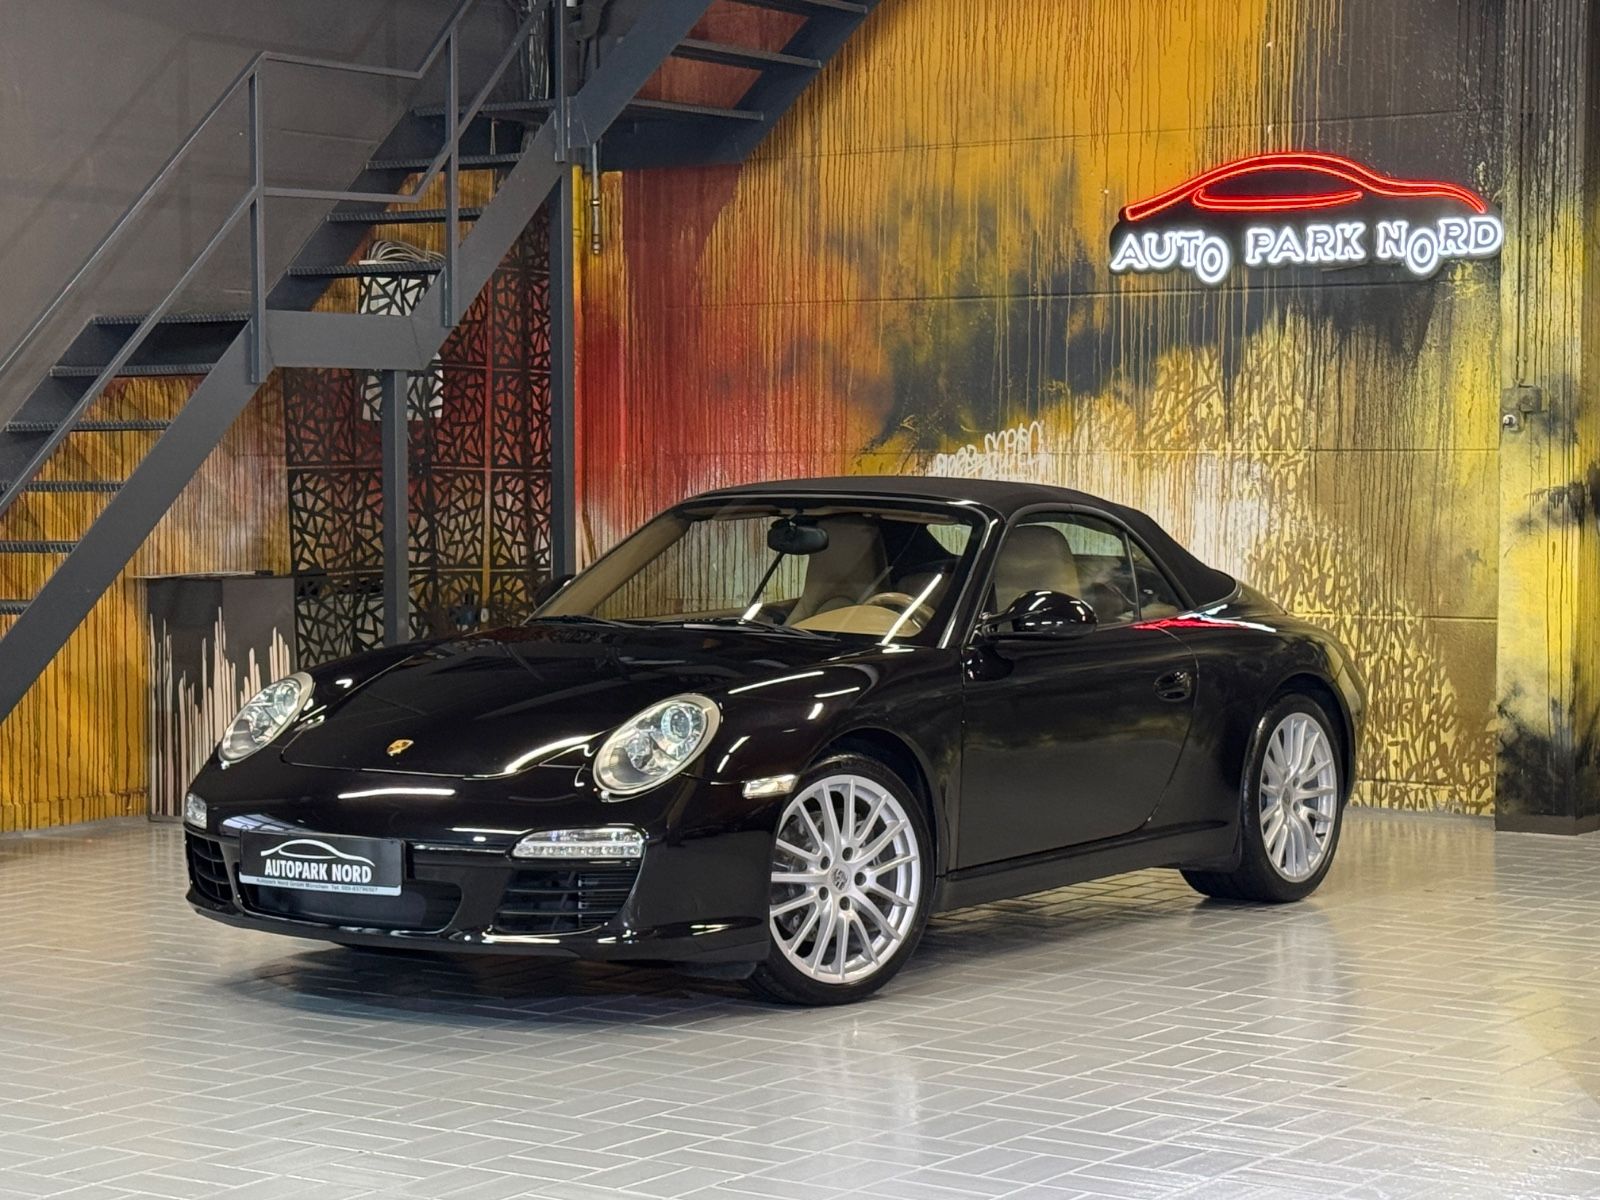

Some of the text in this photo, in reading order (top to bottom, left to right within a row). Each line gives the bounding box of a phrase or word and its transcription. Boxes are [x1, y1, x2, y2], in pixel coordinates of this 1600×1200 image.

[1111, 215, 1502, 283] AUTO PARK NORD
[264, 859, 372, 883] AUTOPARK NORD
